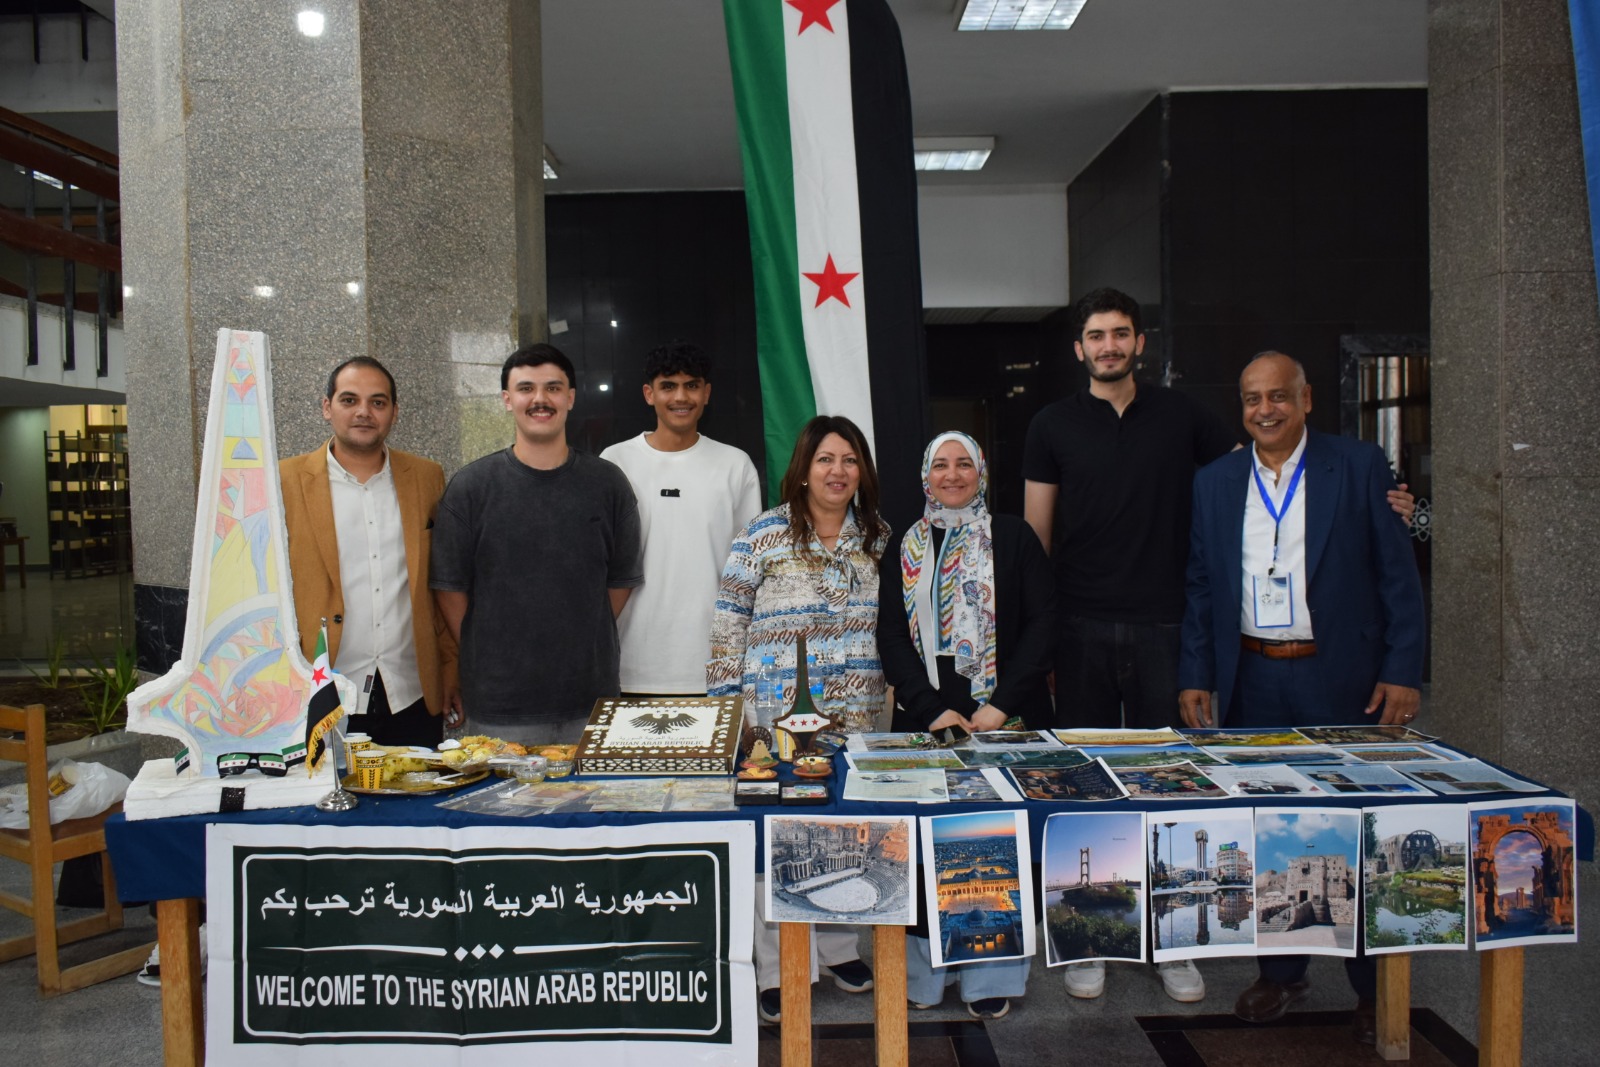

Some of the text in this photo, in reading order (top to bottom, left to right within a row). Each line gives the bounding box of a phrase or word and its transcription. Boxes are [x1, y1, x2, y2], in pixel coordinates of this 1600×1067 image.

[260, 881, 698, 920] الجمهورية العربية السورية ترحب بكم
[255, 970, 708, 1010] WELCOME TO THE SYRIAN ARAB REPUBLIC
